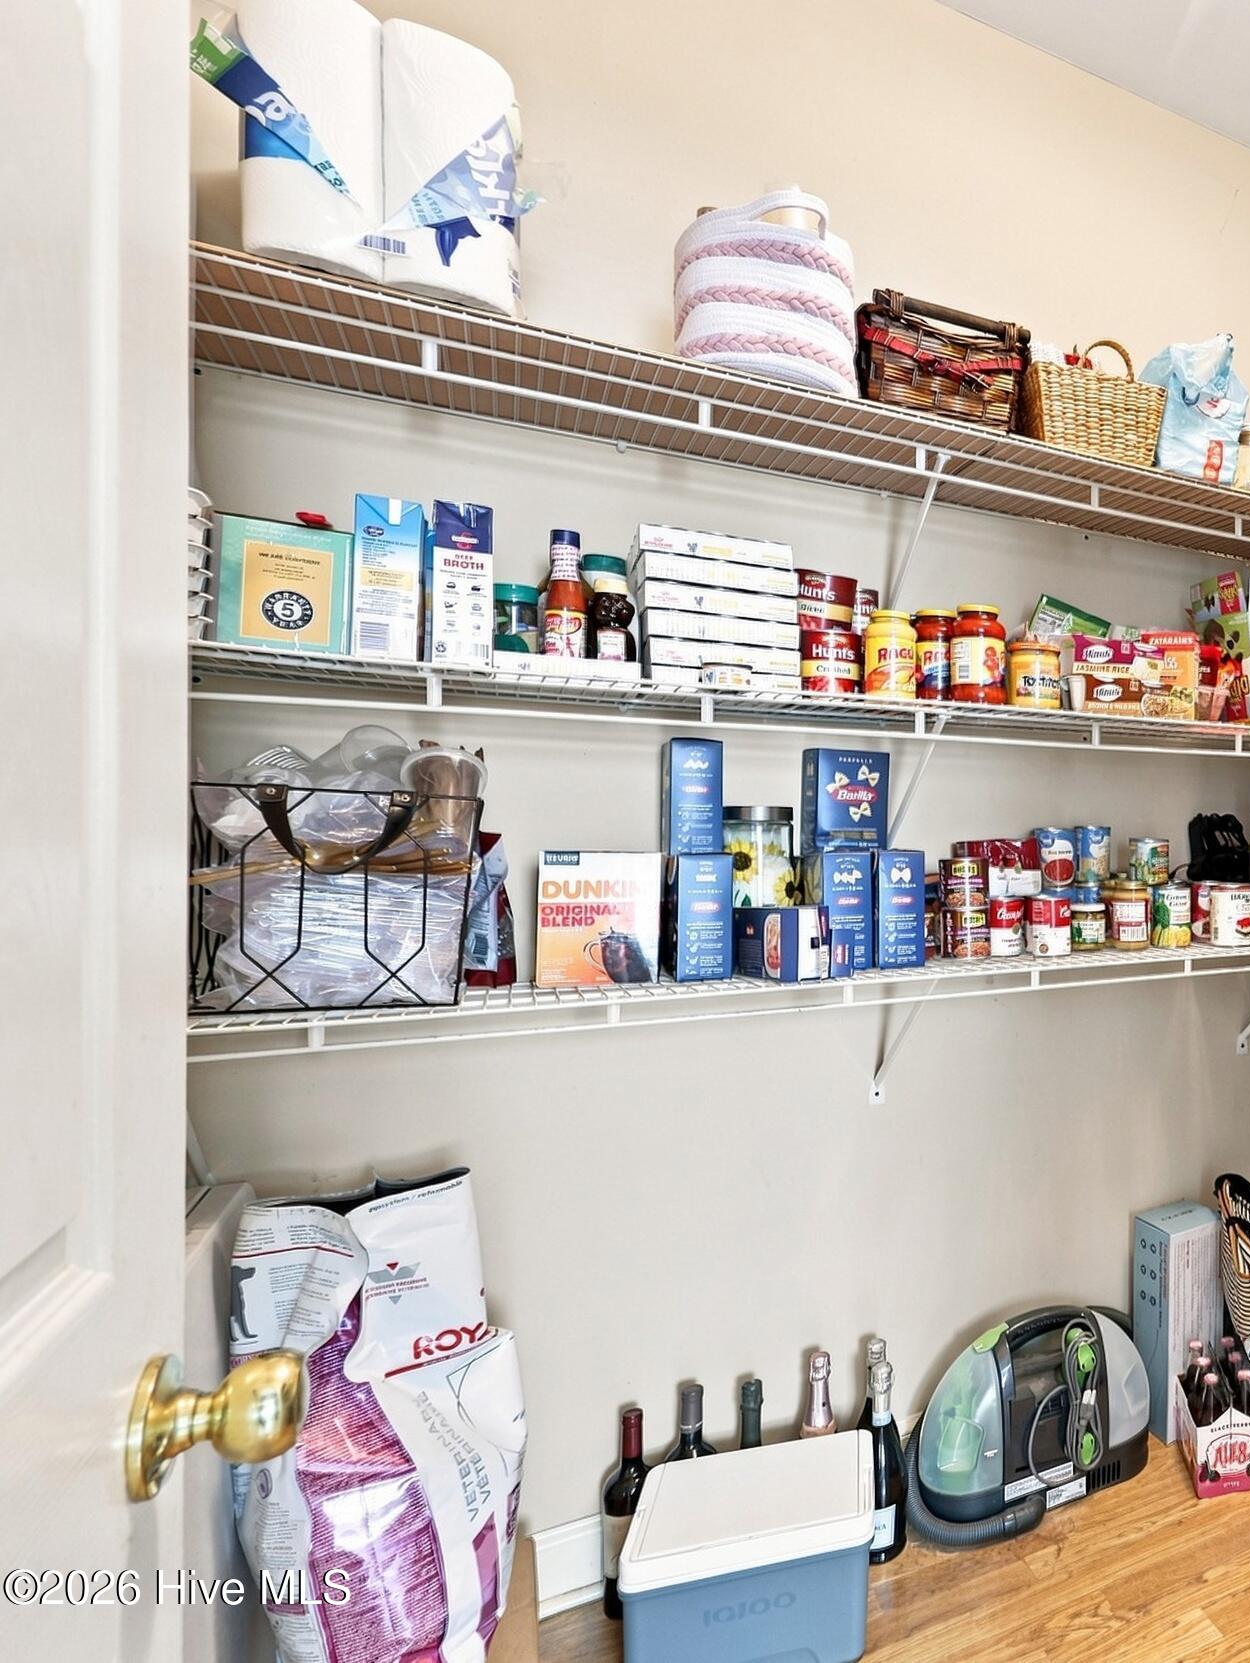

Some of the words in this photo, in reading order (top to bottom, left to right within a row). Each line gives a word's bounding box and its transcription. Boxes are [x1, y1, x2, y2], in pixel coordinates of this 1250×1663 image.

[443, 558, 484, 571] BROTH
[281, 602, 295, 618] 5
[1075, 664, 1110, 674] JASMINE
[1111, 666, 1130, 674] RICE
[836, 789, 873, 801] Barilla
[541, 904, 621, 916] ORIGINAL
[541, 916, 596, 928] BLEND
